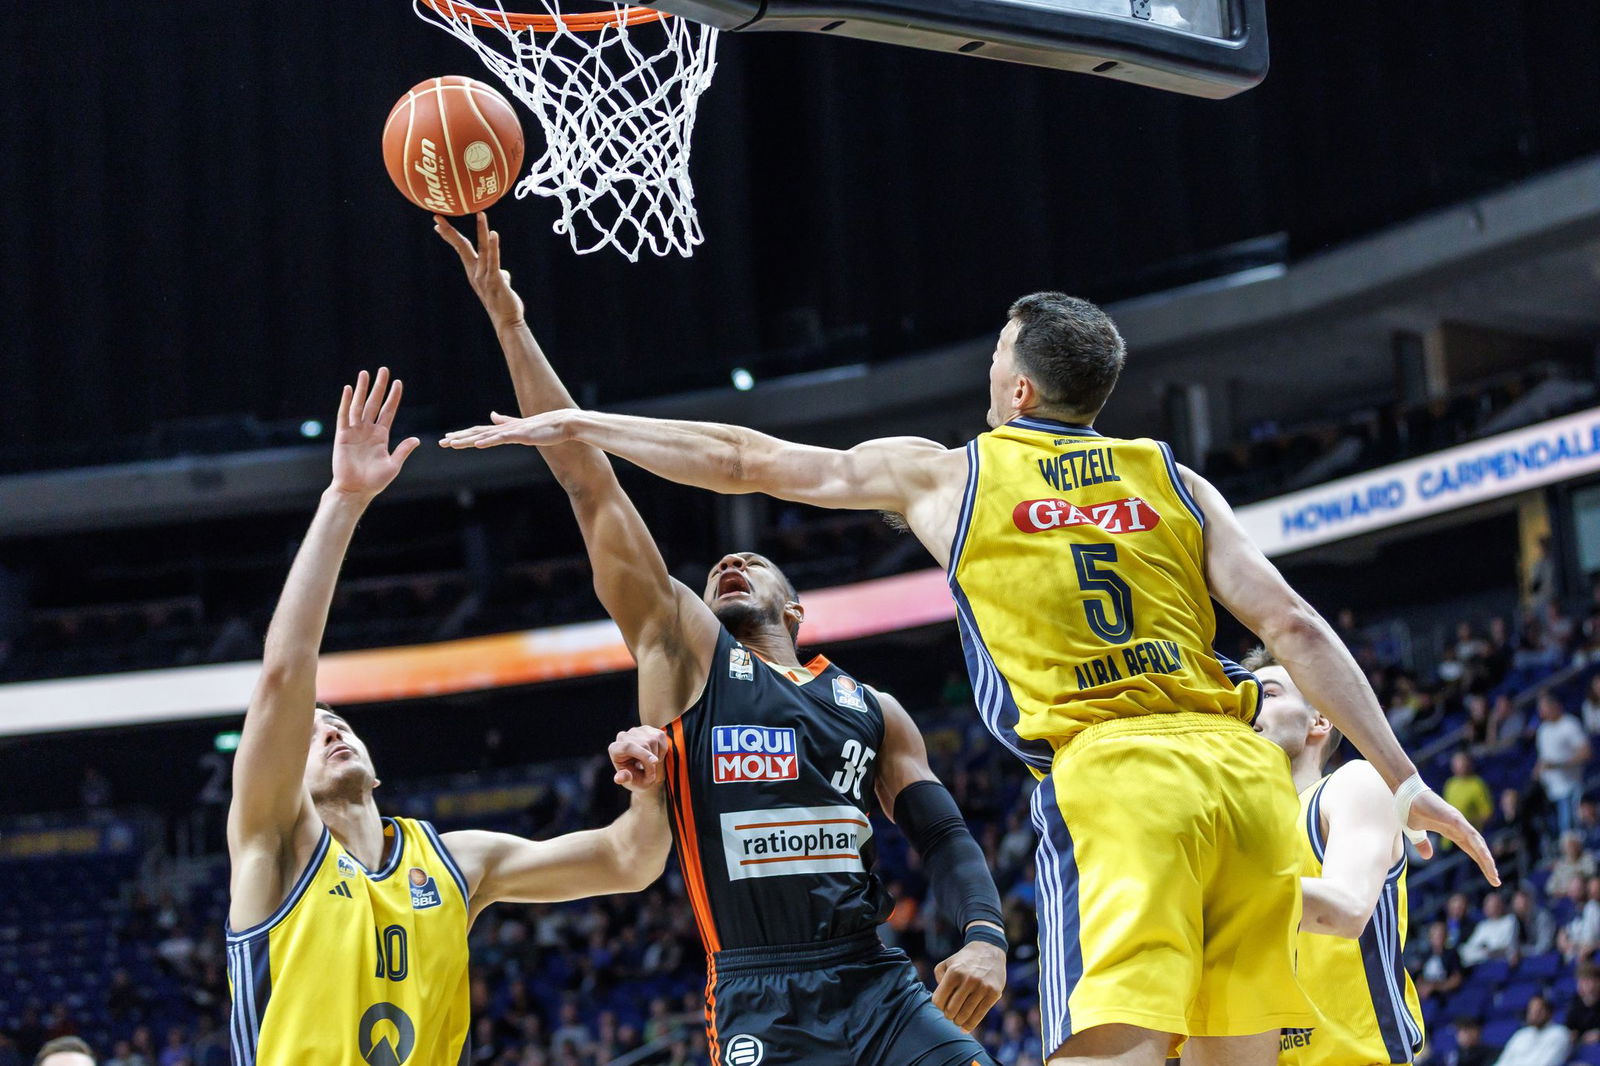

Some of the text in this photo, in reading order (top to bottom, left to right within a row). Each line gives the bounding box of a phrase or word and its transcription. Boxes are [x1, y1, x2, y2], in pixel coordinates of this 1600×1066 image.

[415, 138, 454, 213] Baden
[486, 171, 498, 195] BBL
[1038, 448, 1121, 491] WETZELL
[1281, 480, 1406, 535] HOWARD
[1070, 543, 1134, 645] 5
[717, 728, 791, 753] LIQUI
[718, 755, 795, 780] MOLY
[830, 739, 876, 800] 35
[412, 896, 437, 906] BBL
